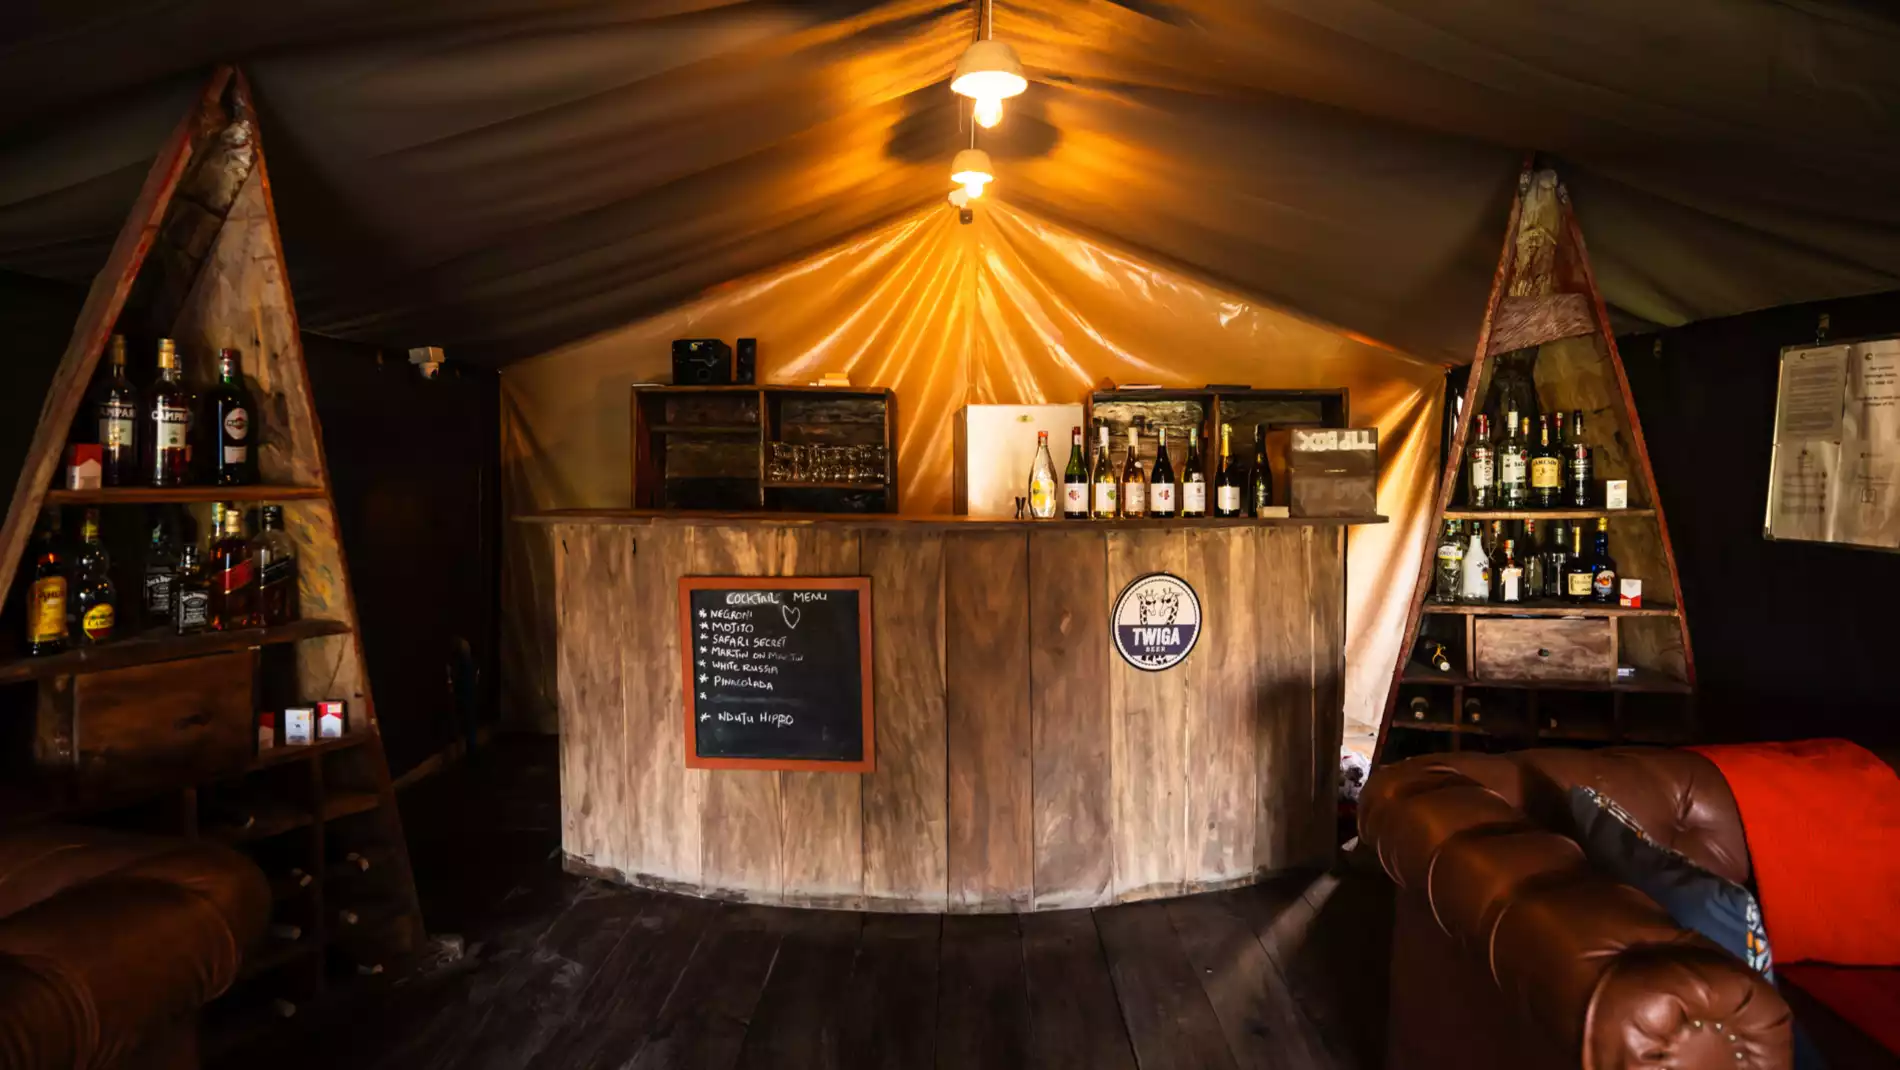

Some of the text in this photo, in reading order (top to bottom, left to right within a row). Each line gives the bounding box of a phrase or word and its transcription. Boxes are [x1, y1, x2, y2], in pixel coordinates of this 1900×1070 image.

[1293, 429, 1376, 452] TIP BOX
[726, 592, 827, 605] COCKTAIL MENU
[710, 609, 753, 621] NEGRONI
[711, 622, 754, 634] MOJITO
[712, 634, 787, 648] SAFARI SECRET
[1132, 627, 1181, 646] TWIGA
[711, 646, 749, 659] MARTIN
[752, 652, 766, 660] ON
[712, 660, 740, 672] WHITE
[718, 711, 754, 725] NDUTU
